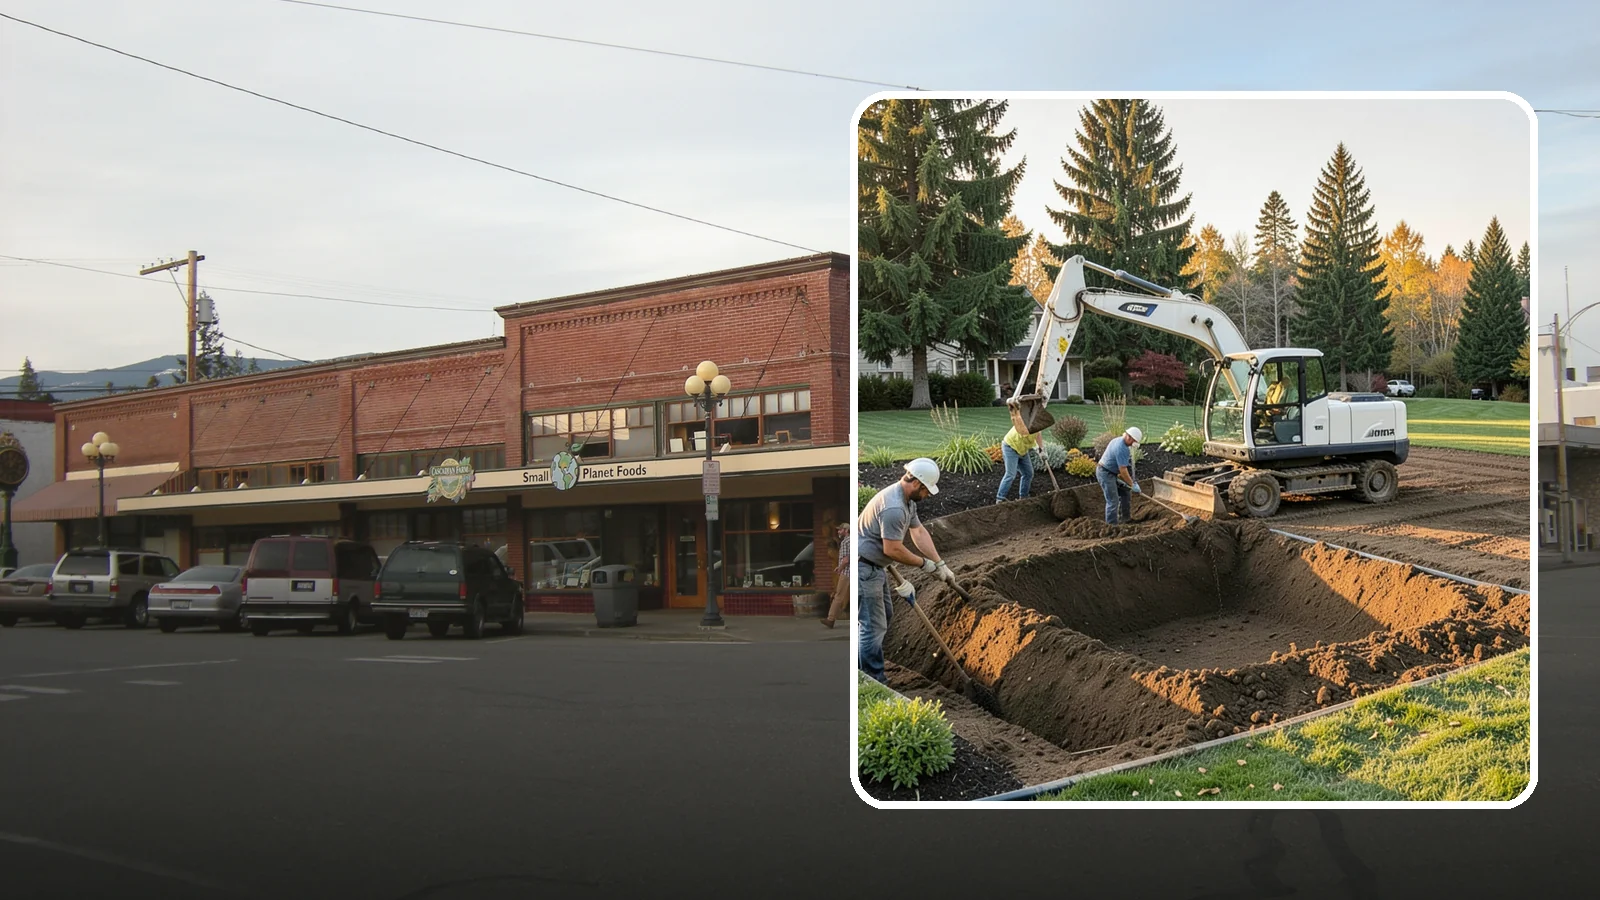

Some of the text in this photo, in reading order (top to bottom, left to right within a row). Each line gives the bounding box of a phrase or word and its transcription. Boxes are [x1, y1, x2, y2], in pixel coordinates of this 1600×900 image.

[523, 464, 647, 483] Small Planet Foods
